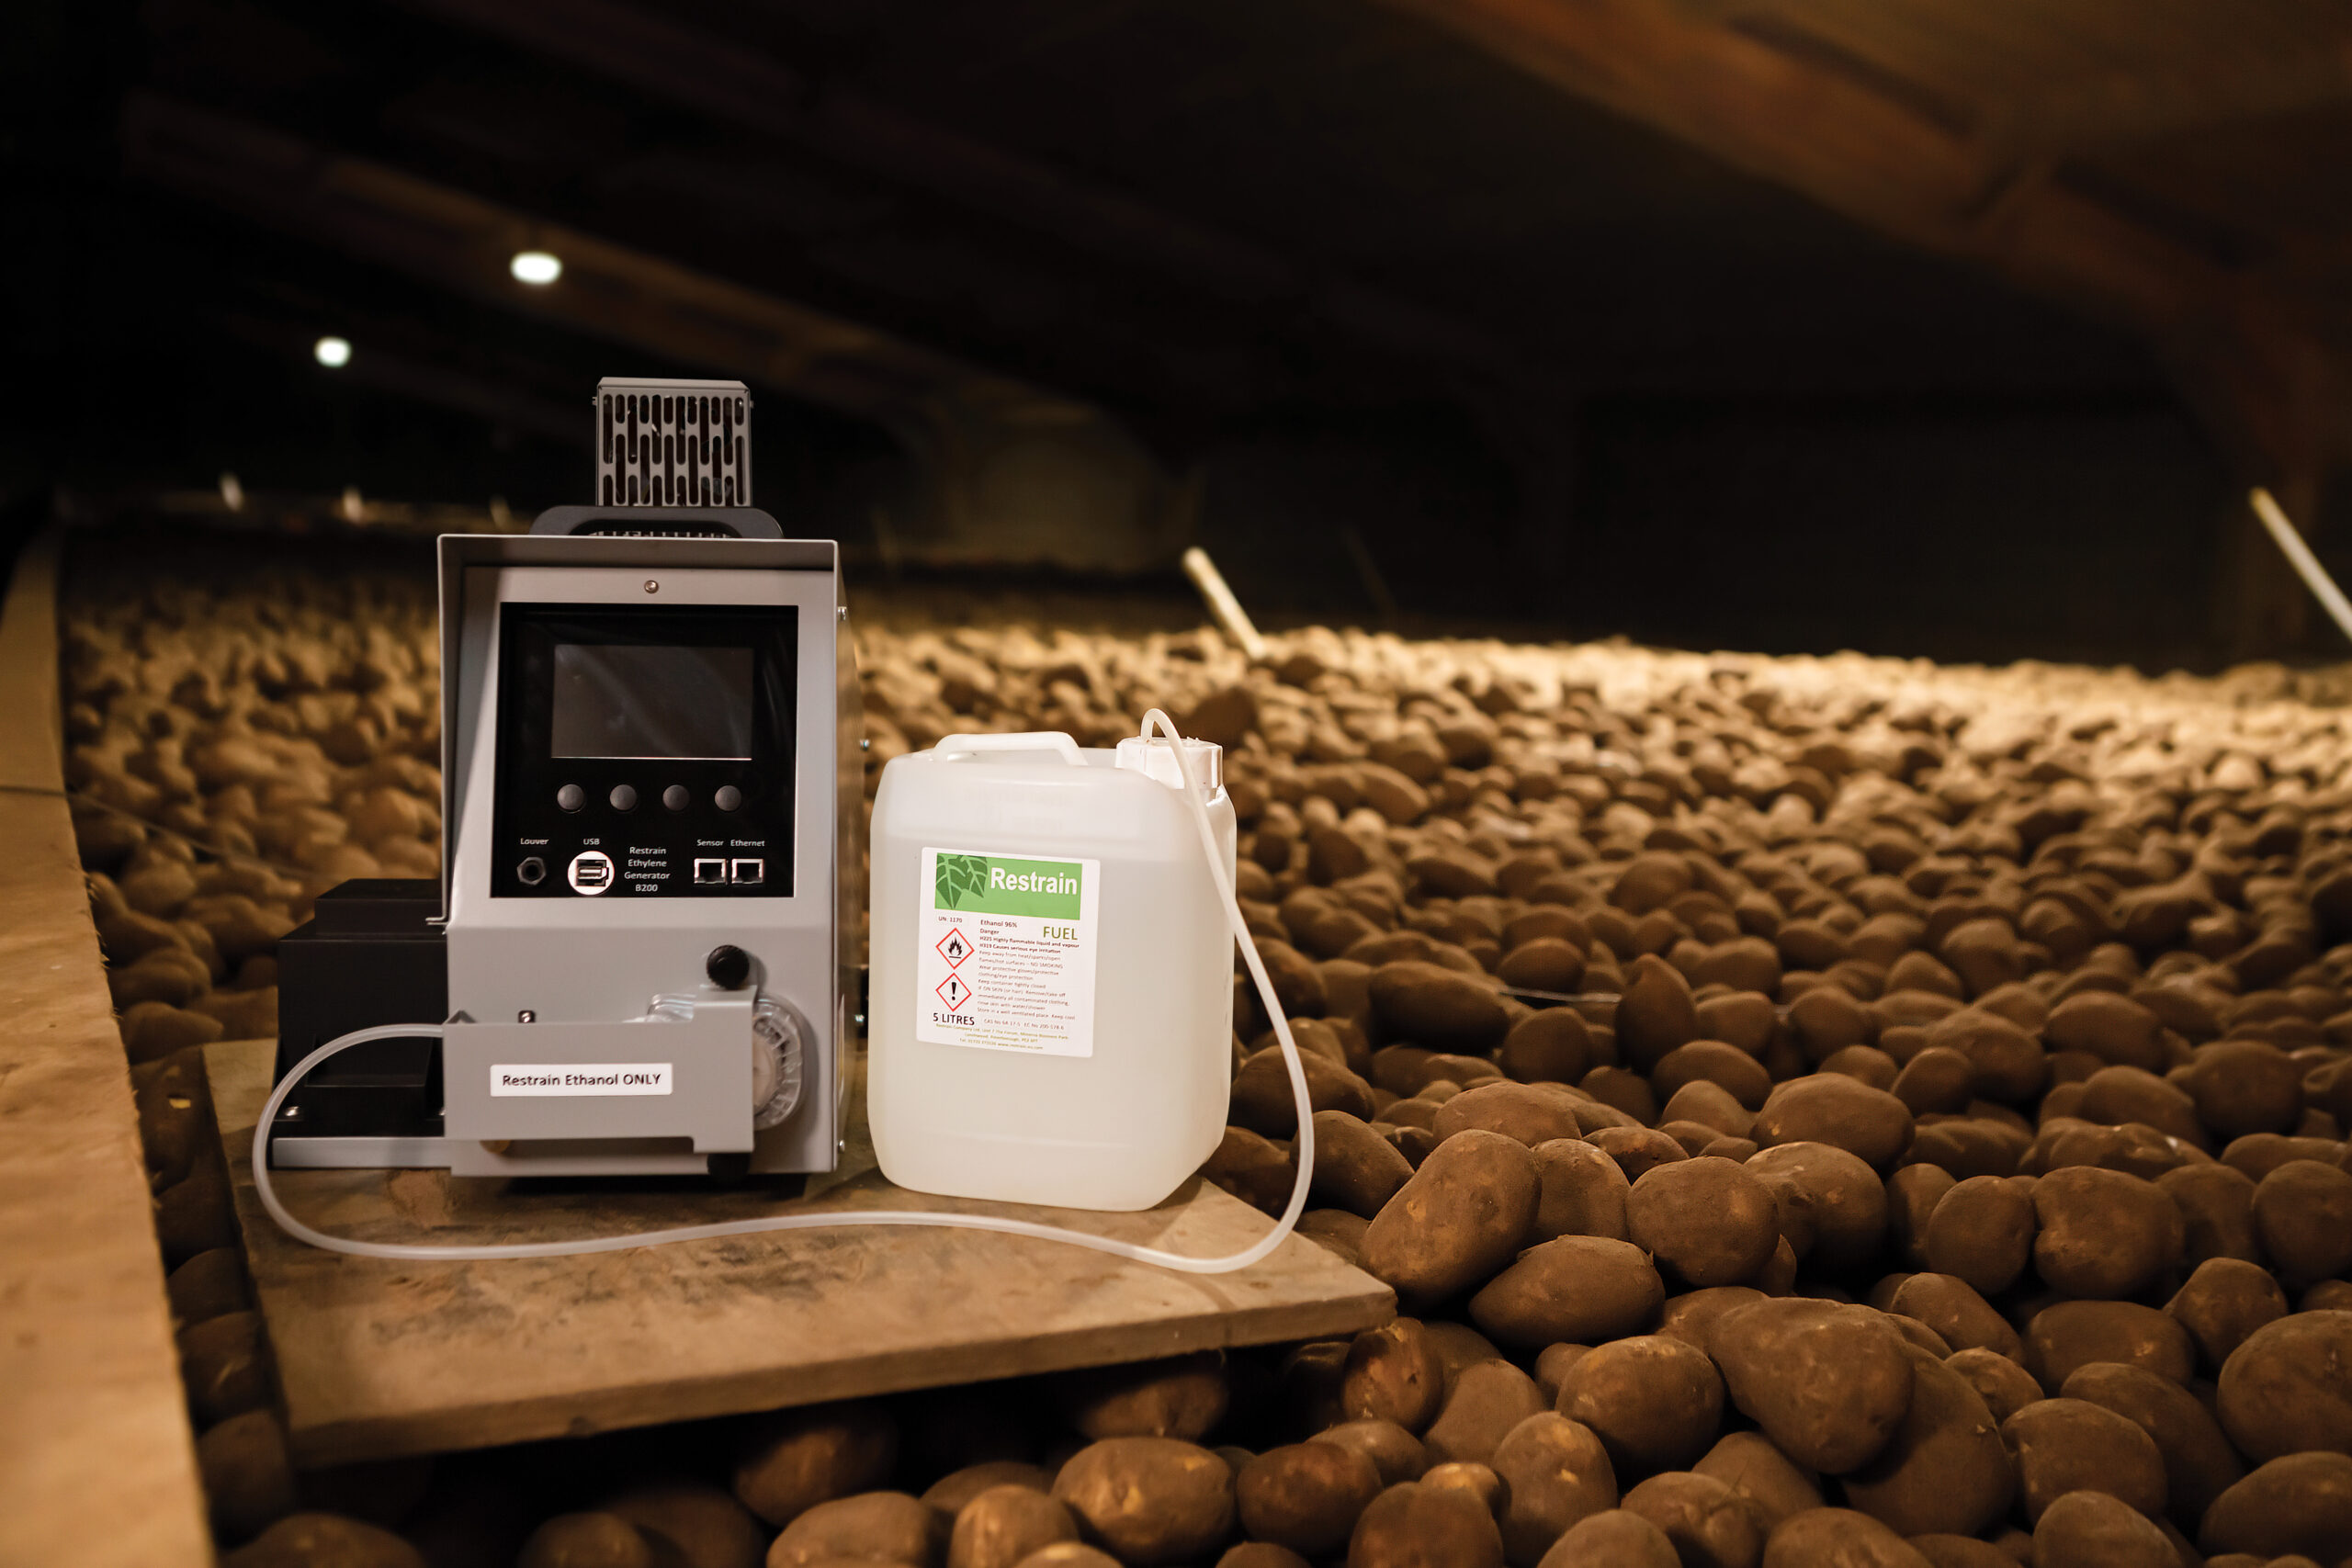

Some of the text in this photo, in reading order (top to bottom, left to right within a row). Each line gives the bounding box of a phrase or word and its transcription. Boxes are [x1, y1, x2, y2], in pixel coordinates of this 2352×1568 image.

[520, 837, 549, 846] Louver
[582, 838, 600, 846] USB
[696, 839, 765, 847] Sensor Ethernet
[629, 846, 667, 855] Restrain
[628, 859, 667, 868] Ethylene
[624, 871, 671, 880] Generator
[990, 867, 1078, 895] Restrain
[635, 884, 659, 892] B200
[1043, 926, 1078, 940] FUEL
[933, 1012, 975, 1026] 5 LITRES
[502, 1073, 662, 1086] Restrain Ethanol ONLY
